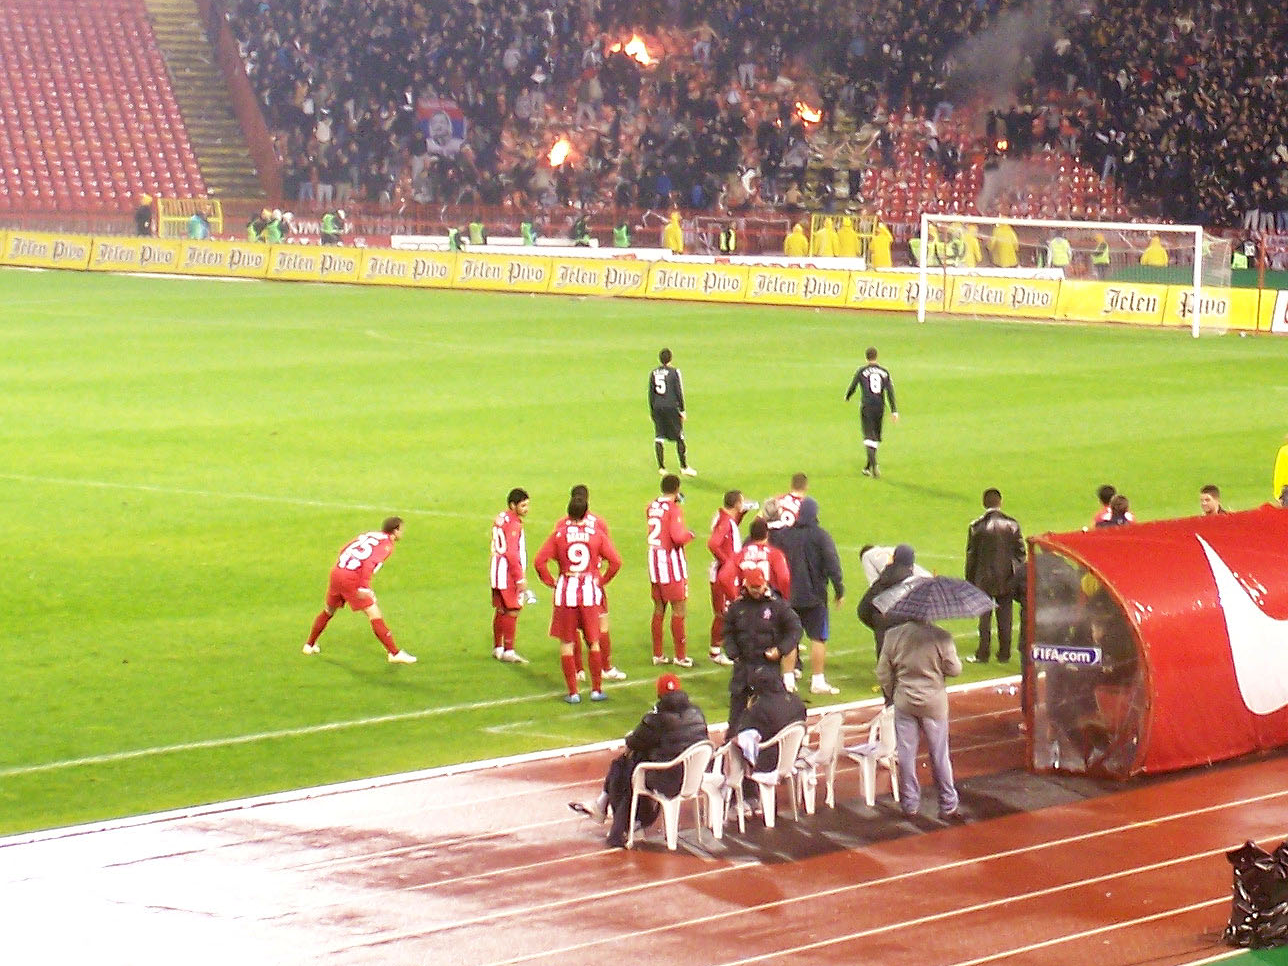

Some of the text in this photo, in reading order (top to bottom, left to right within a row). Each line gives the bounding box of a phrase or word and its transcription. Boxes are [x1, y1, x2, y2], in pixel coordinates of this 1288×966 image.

[9, 237, 85, 261] Jelen Pivo
[95, 242, 174, 266] Jelen Pivo
[184, 247, 263, 269] Jelen Pivo
[274, 252, 355, 275] Jelen Pivo
[366, 257, 448, 280] Jelen Pivo
[461, 260, 544, 283] Jelen Pivo
[557, 265, 641, 289] Jelen Pivo
[654, 270, 740, 294] Jelen Pivo
[754, 274, 841, 298] Jelen Pivo
[853, 279, 944, 303] Jelen Pvo
[958, 283, 1050, 309] Jelen Pivo
[1103, 288, 1157, 314] Jelen
[654, 374, 667, 395] 5
[647, 517, 662, 546] 2
[567, 542, 591, 573] 9
[1032, 646, 1091, 664] FIFA.com
